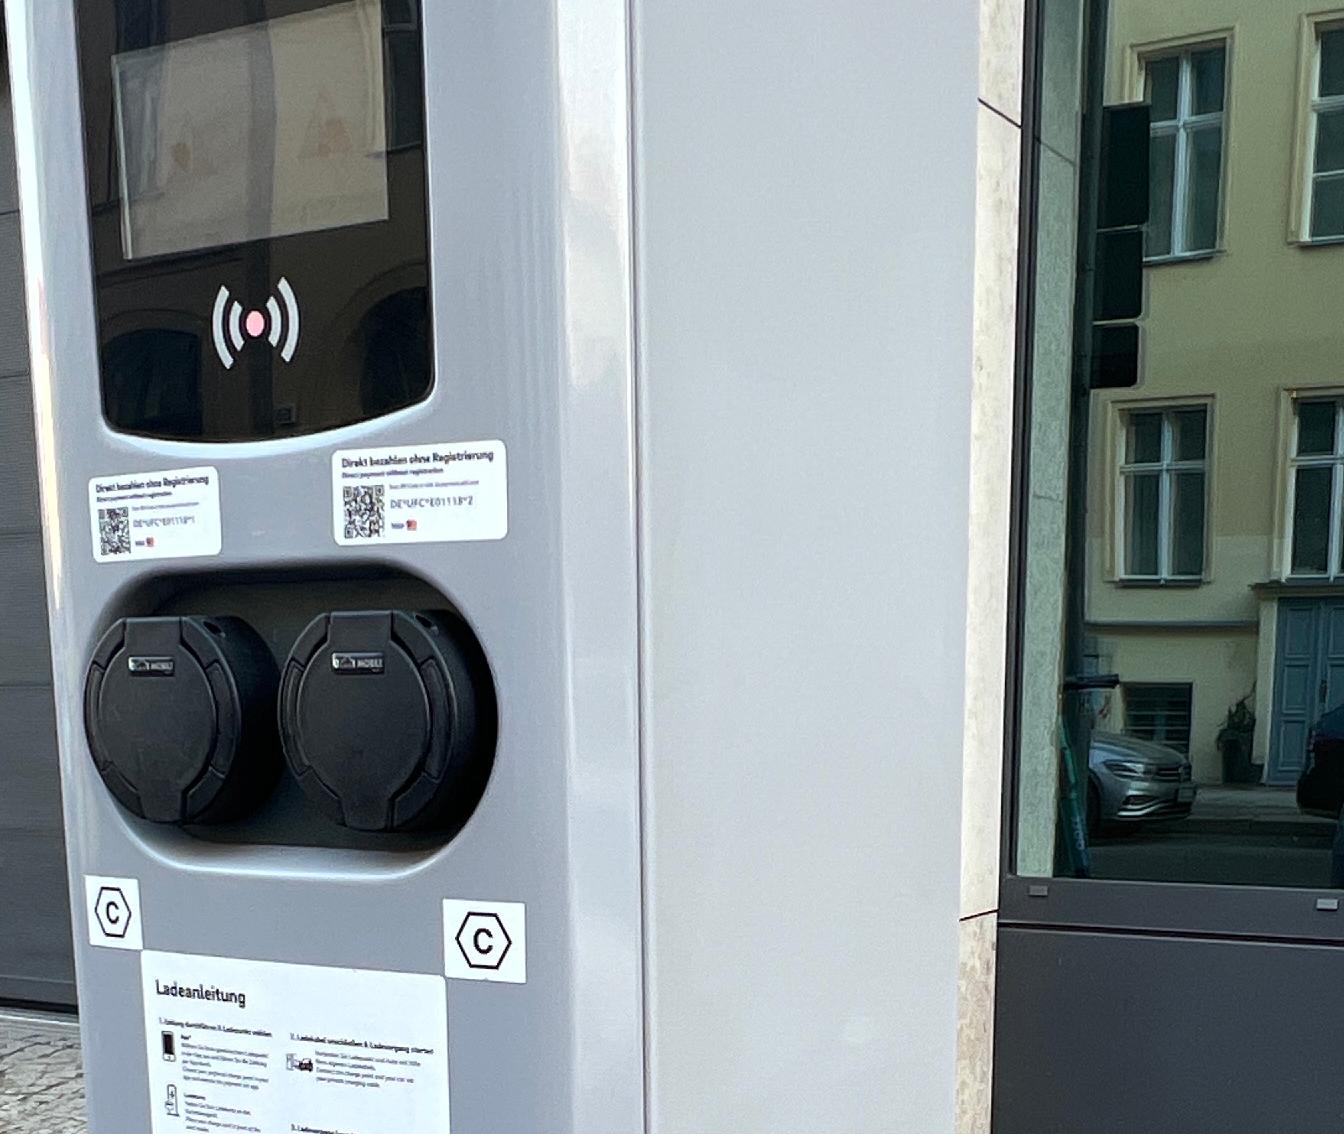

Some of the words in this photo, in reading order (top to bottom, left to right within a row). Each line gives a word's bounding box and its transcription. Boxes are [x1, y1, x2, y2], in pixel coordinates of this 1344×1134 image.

[409, 454, 430, 464] ohne
[432, 450, 494, 465] Registrierung
[106, 901, 120, 924] C
[472, 927, 494, 955] C
[155, 979, 246, 1009] Ladeanleitung
